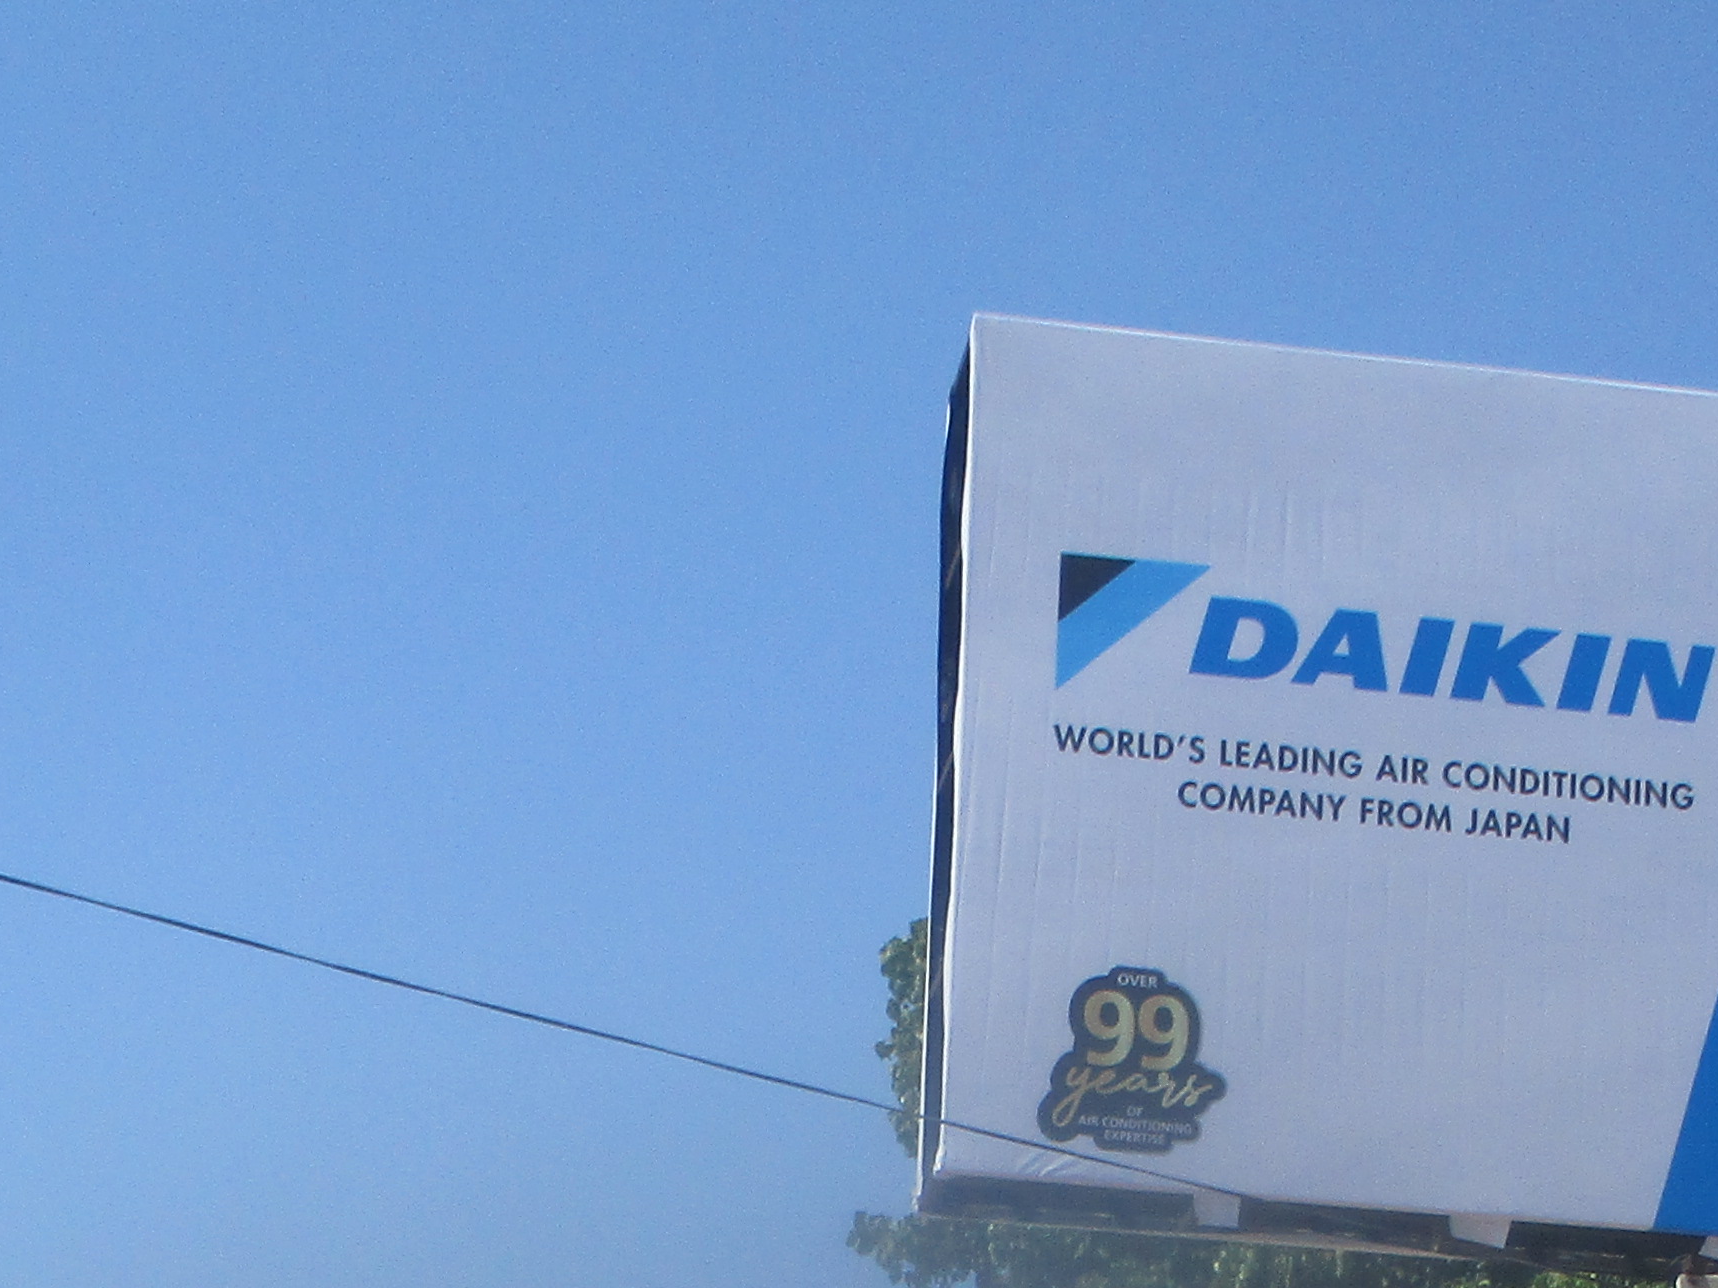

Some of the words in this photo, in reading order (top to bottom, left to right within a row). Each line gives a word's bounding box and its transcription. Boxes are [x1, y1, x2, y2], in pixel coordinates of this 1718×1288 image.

[1189, 595, 1716, 723] DAIKIN
[1219, 738, 1363, 780] LEADING
[1376, 755, 1430, 786] AIR
[1443, 760, 1696, 811] CONDITIONING
[1178, 781, 1346, 822] COMPANY
[1360, 798, 1453, 834] FROM
[1465, 809, 1571, 845] JAPAN
[1117, 973, 1158, 989] OVER
[1084, 990, 1189, 1071] 99
[1101, 1117, 1192, 1136] CONDITIONING
